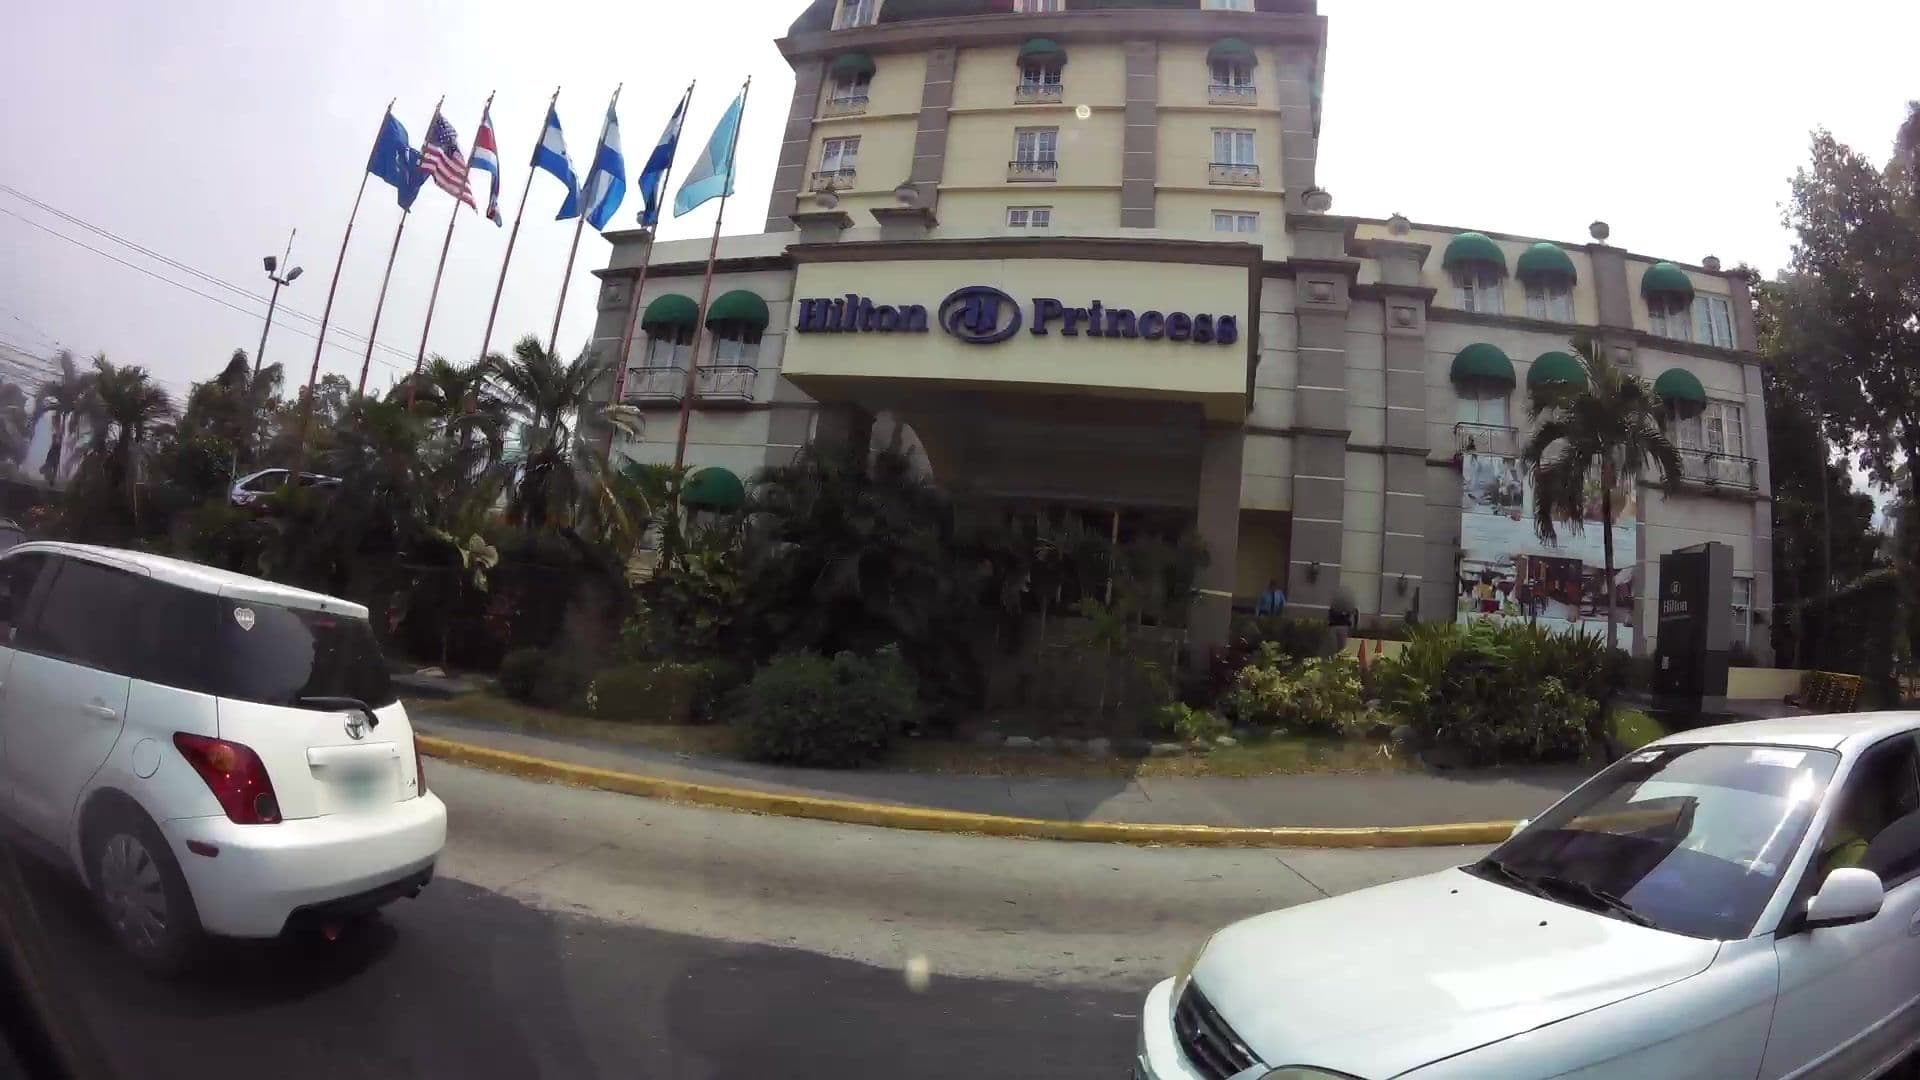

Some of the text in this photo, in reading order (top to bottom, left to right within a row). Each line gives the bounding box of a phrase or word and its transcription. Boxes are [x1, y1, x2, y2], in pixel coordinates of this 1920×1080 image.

[796, 294, 929, 333] Hilton
[1030, 297, 1237, 344] Princess
[1663, 599, 1688, 613] Hilton
